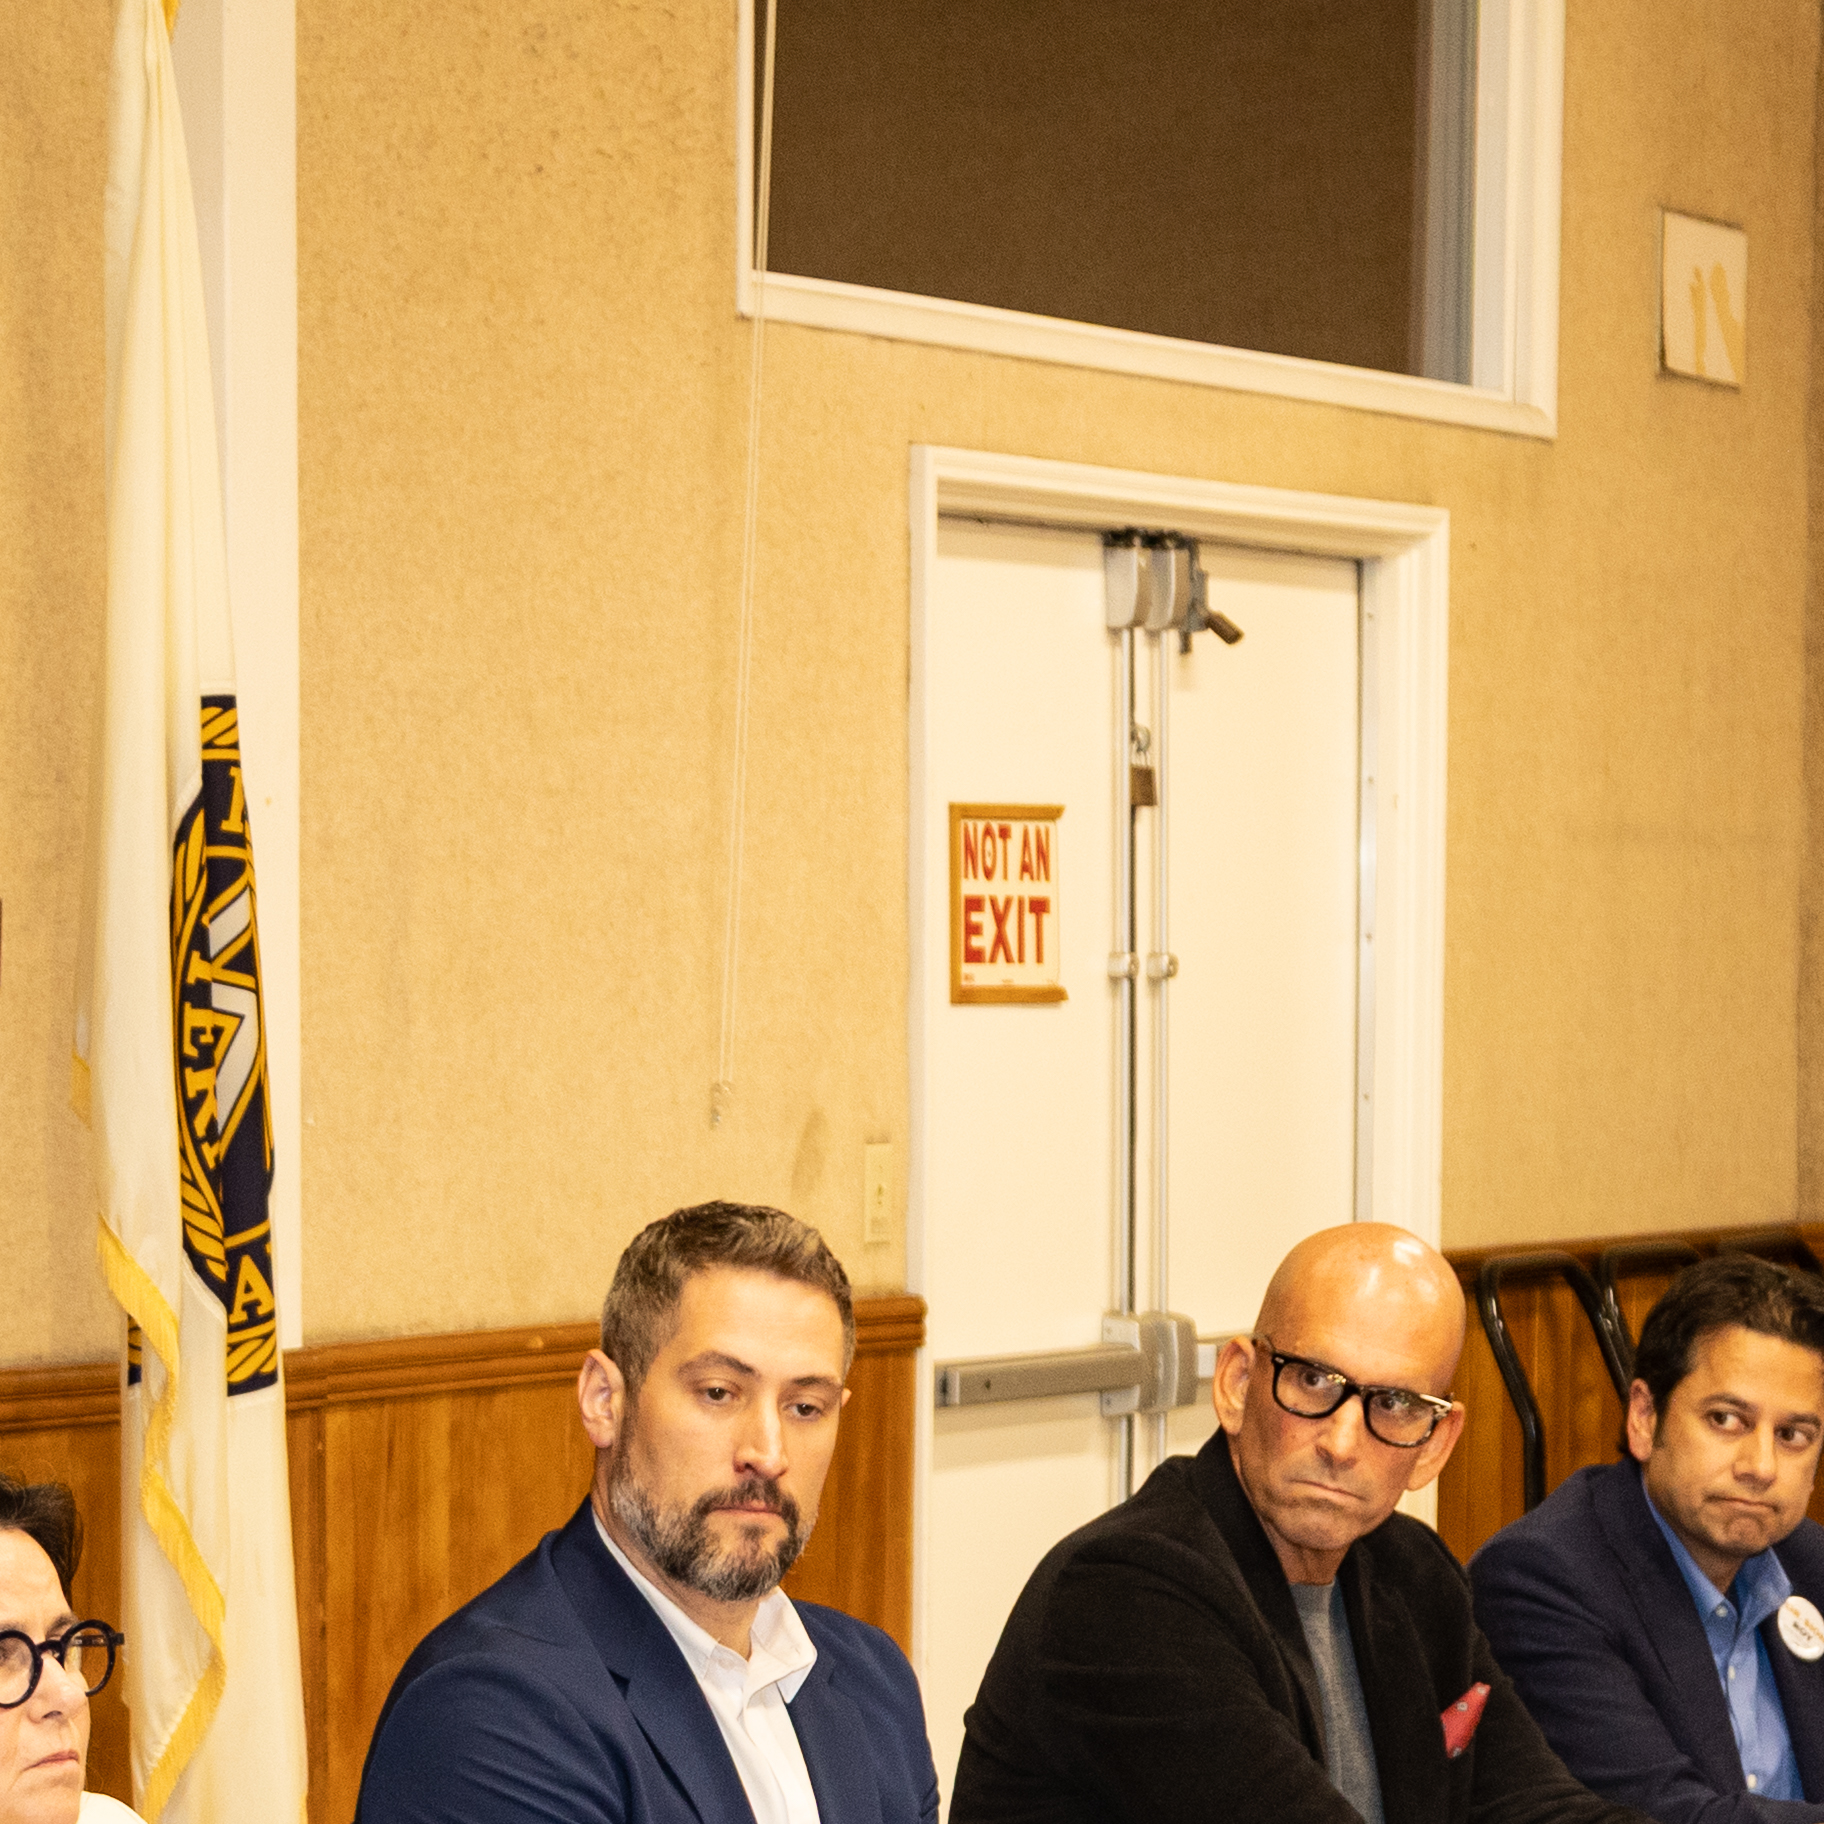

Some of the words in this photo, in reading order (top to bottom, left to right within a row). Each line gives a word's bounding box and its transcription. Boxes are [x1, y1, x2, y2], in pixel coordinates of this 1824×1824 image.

[963, 821, 1011, 881] NOT
[1019, 823, 1051, 882] AN
[963, 894, 1051, 964] EXIT
